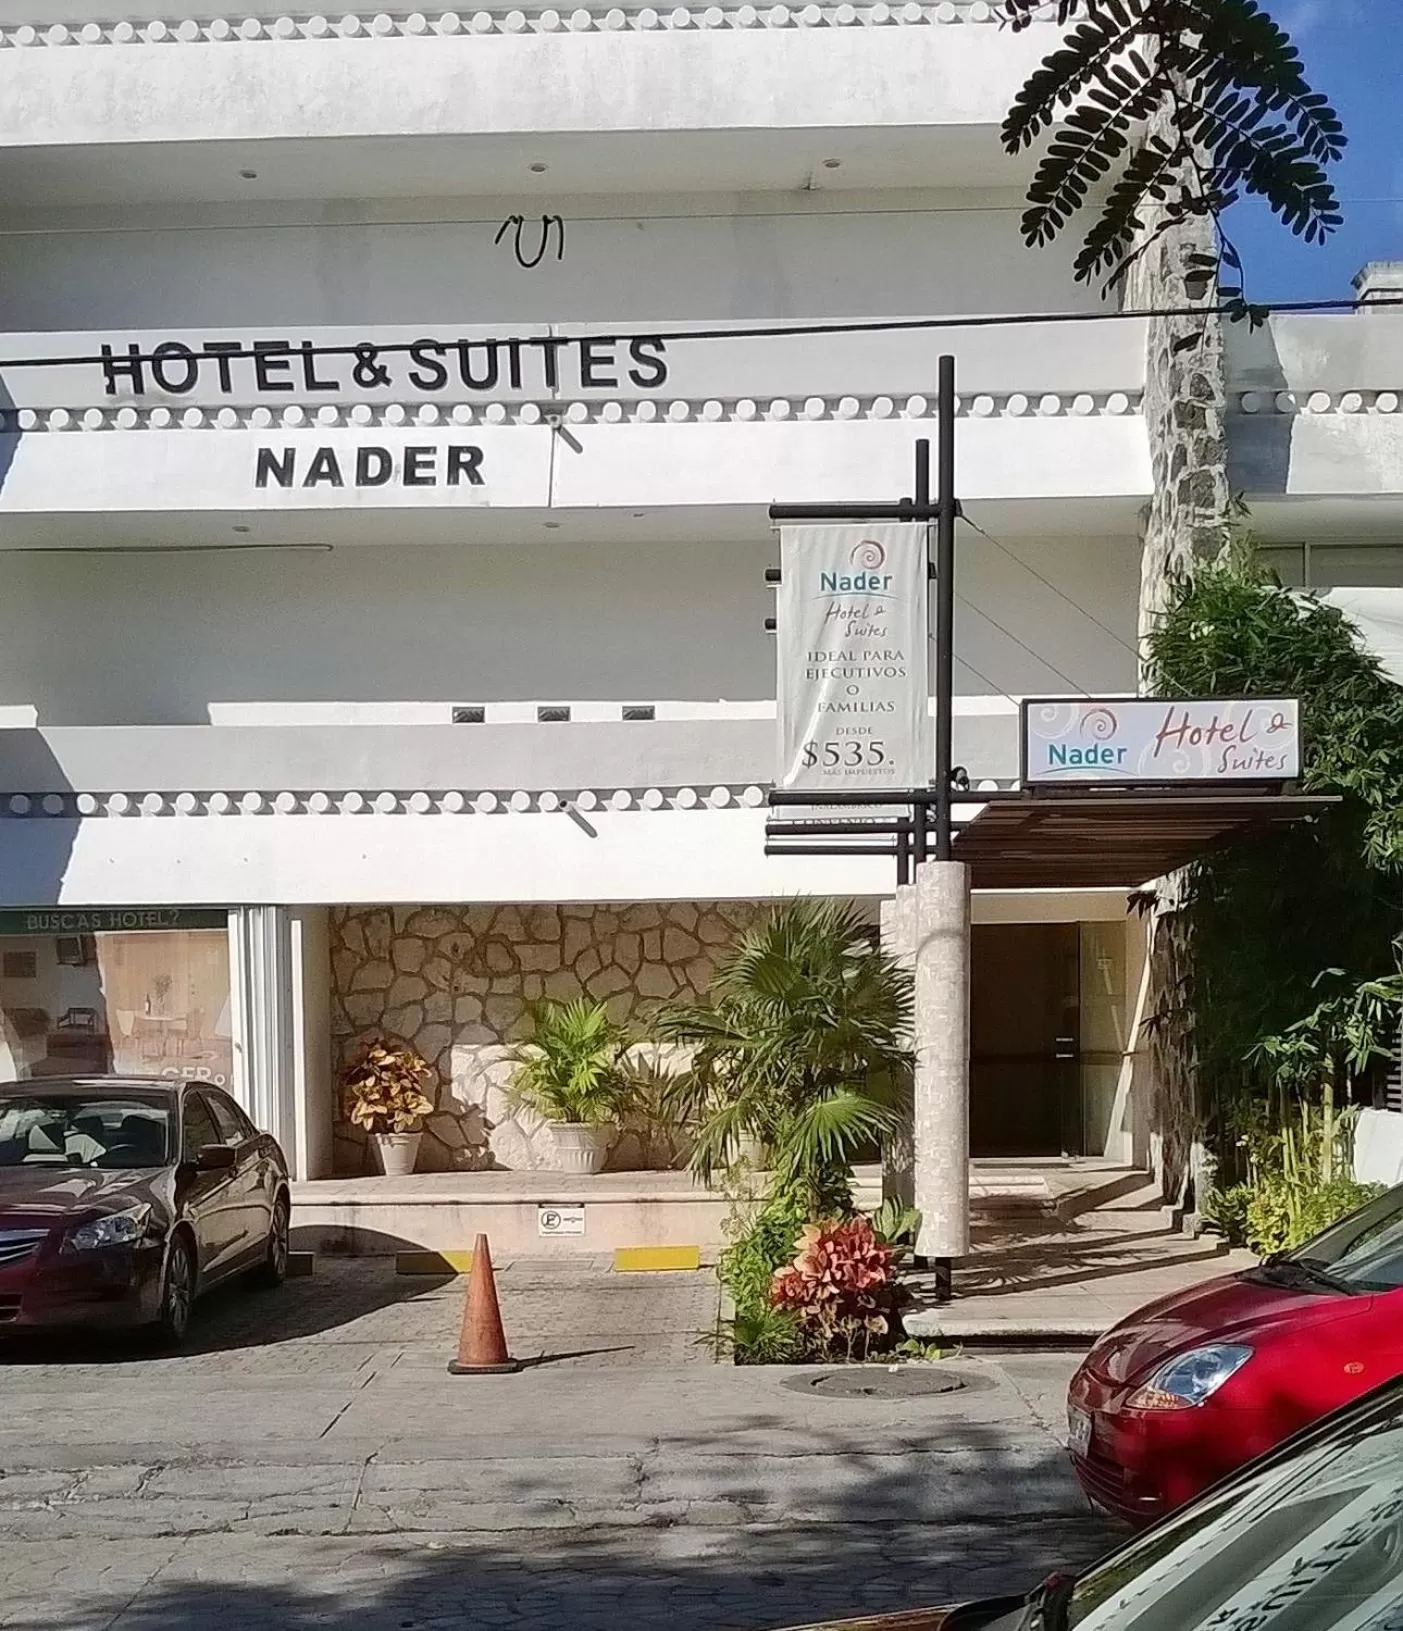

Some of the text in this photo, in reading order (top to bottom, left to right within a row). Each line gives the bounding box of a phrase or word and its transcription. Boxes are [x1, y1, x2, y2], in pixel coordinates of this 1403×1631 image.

[101, 336, 668, 394] HOTEL & SUITES
[254, 444, 486, 488] NADER
[820, 571, 893, 591] Nader
[824, 601, 869, 624] Hotel
[845, 620, 888, 637] Suites
[807, 650, 905, 662] IDEAL PARA
[806, 666, 907, 680] EJECUTIVOS
[846, 684, 860, 696] O
[818, 700, 896, 713] FAMILIAS
[835, 727, 873, 735] DESDE
[1153, 705, 1258, 757] Hotel
[1049, 744, 1127, 765] Nader
[1217, 744, 1287, 773] Suites
[27, 909, 180, 931] BUSCAS HOTEL?
